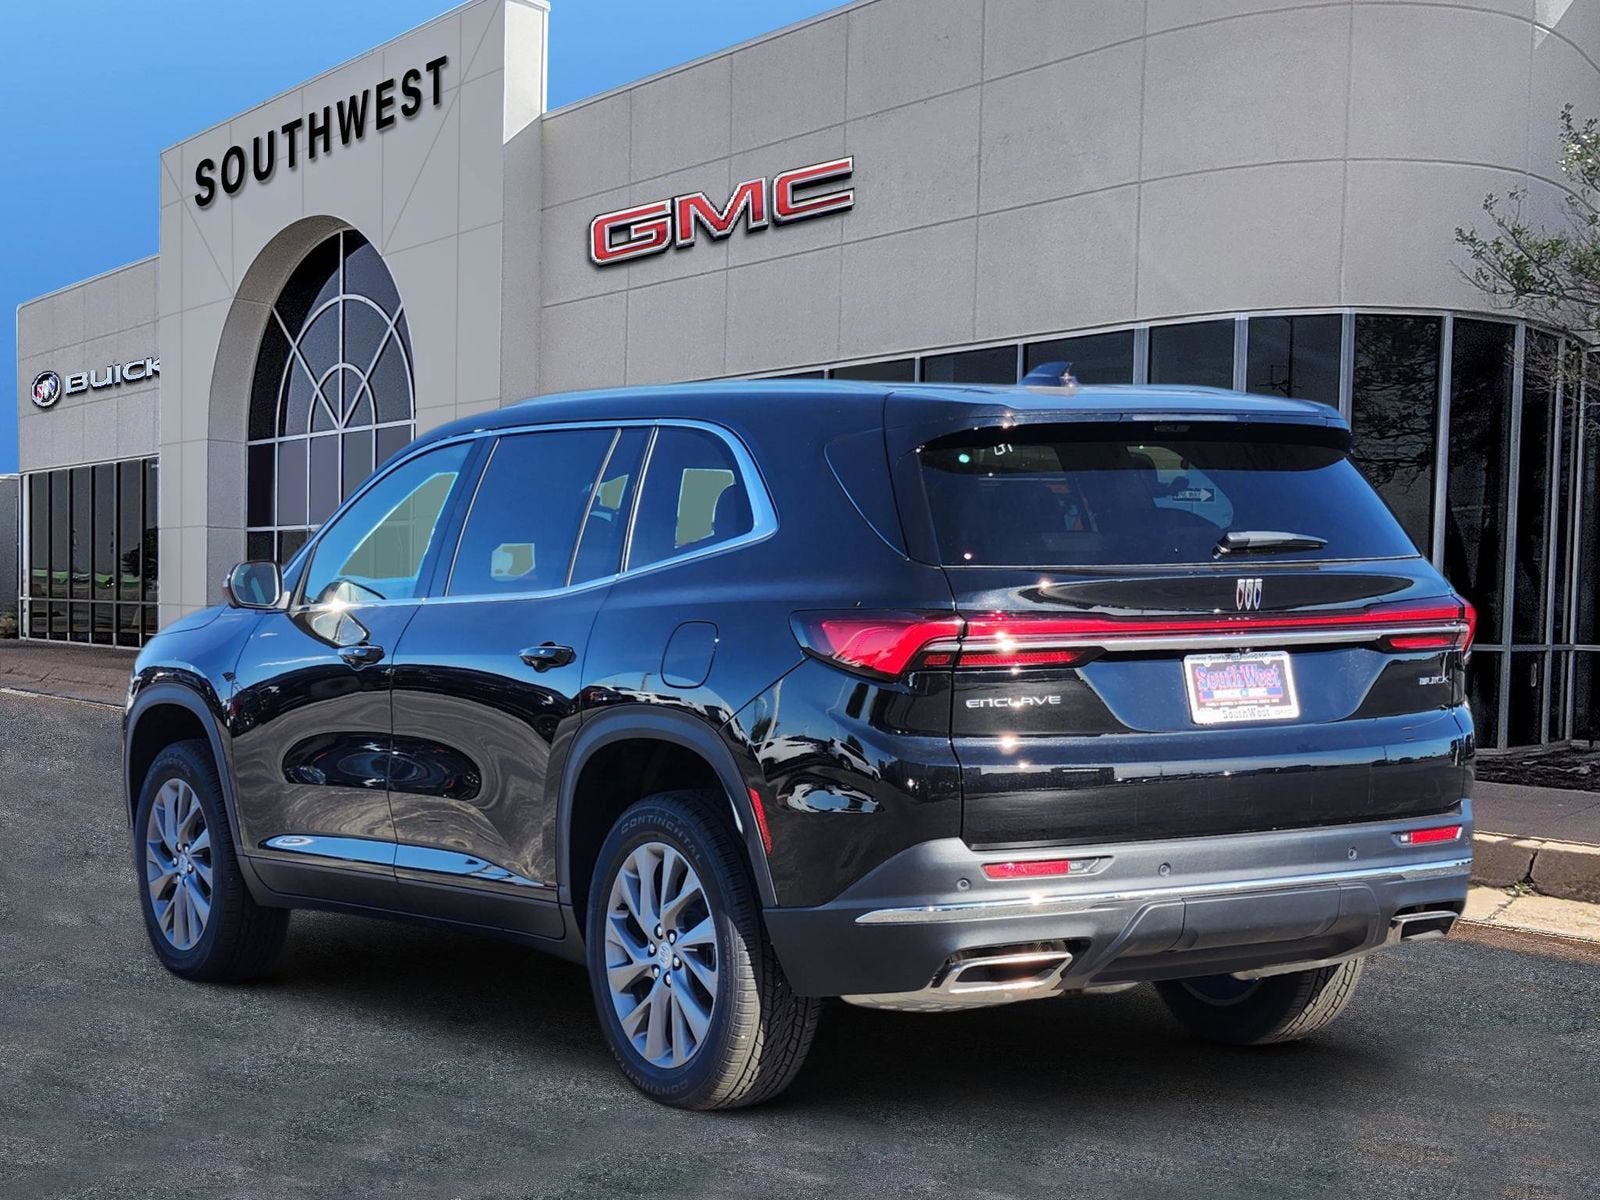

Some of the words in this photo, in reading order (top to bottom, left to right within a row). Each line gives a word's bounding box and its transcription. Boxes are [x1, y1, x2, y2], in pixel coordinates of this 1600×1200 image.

[194, 55, 448, 208] SOUTHWEST
[589, 156, 855, 265] GMC
[64, 356, 160, 395] BUICK
[1195, 663, 1282, 691] SouthWest
[1419, 675, 1449, 685] BUICK
[965, 695, 1062, 708] ENCLAVE
